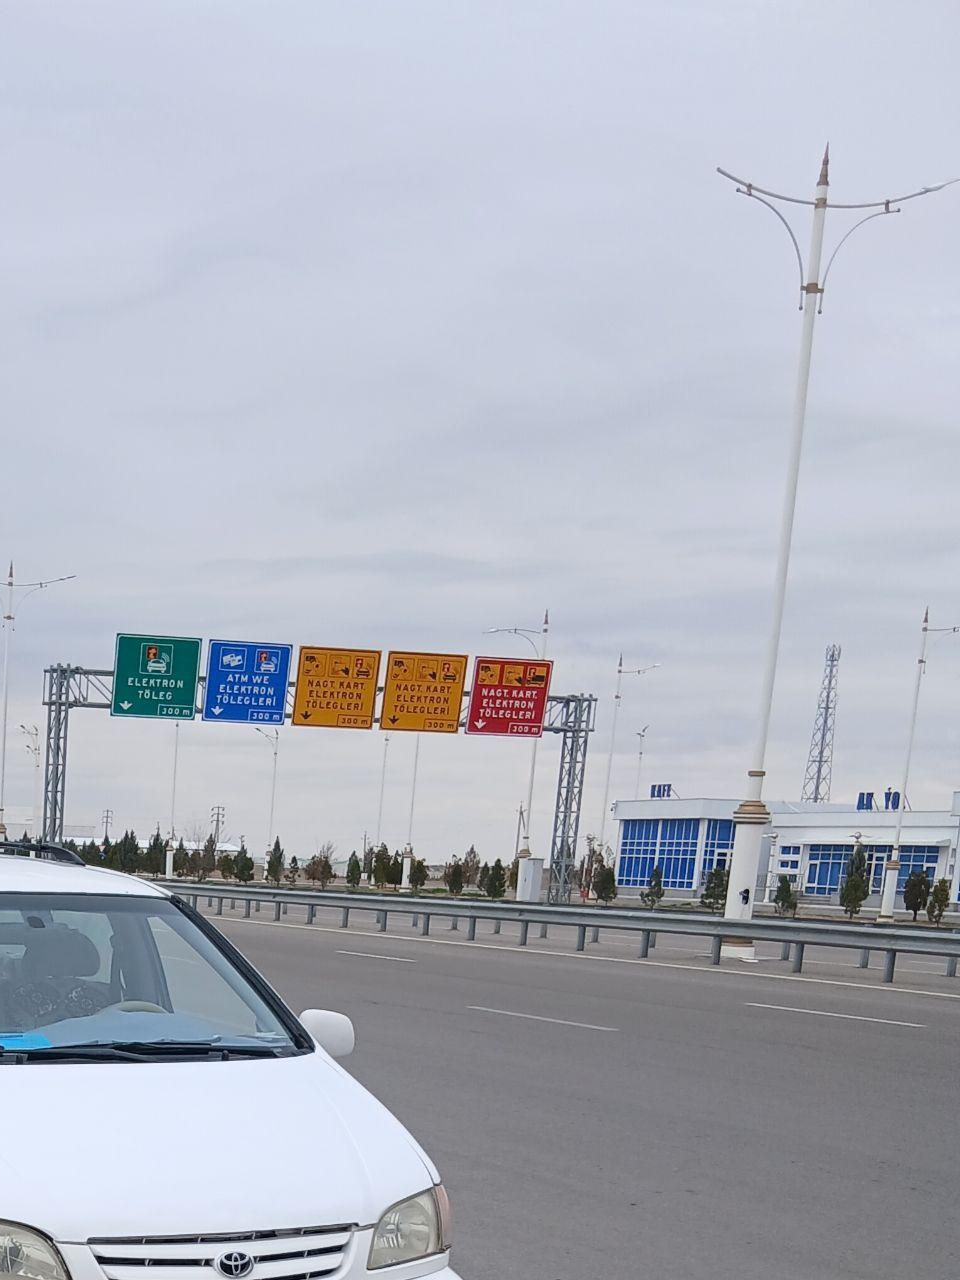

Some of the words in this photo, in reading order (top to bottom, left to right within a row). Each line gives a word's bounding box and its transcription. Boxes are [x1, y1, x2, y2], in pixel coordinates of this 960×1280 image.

[127, 677, 184, 689] ELEKTRON
[226, 673, 248, 683] ATM
[252, 675, 270, 684] WE
[138, 689, 173, 701] TÖLEG
[219, 684, 274, 696] ELEKTRON
[308, 689, 362, 700] ELEKTRON
[396, 694, 450, 705] ELEKTRON
[482, 698, 534, 709] ELEKTRON
[161, 707, 180, 715] 300
[252, 712, 270, 720] 300
[341, 717, 358, 725] 300
[427, 721, 444, 729] 300
[512, 725, 529, 733] 300
